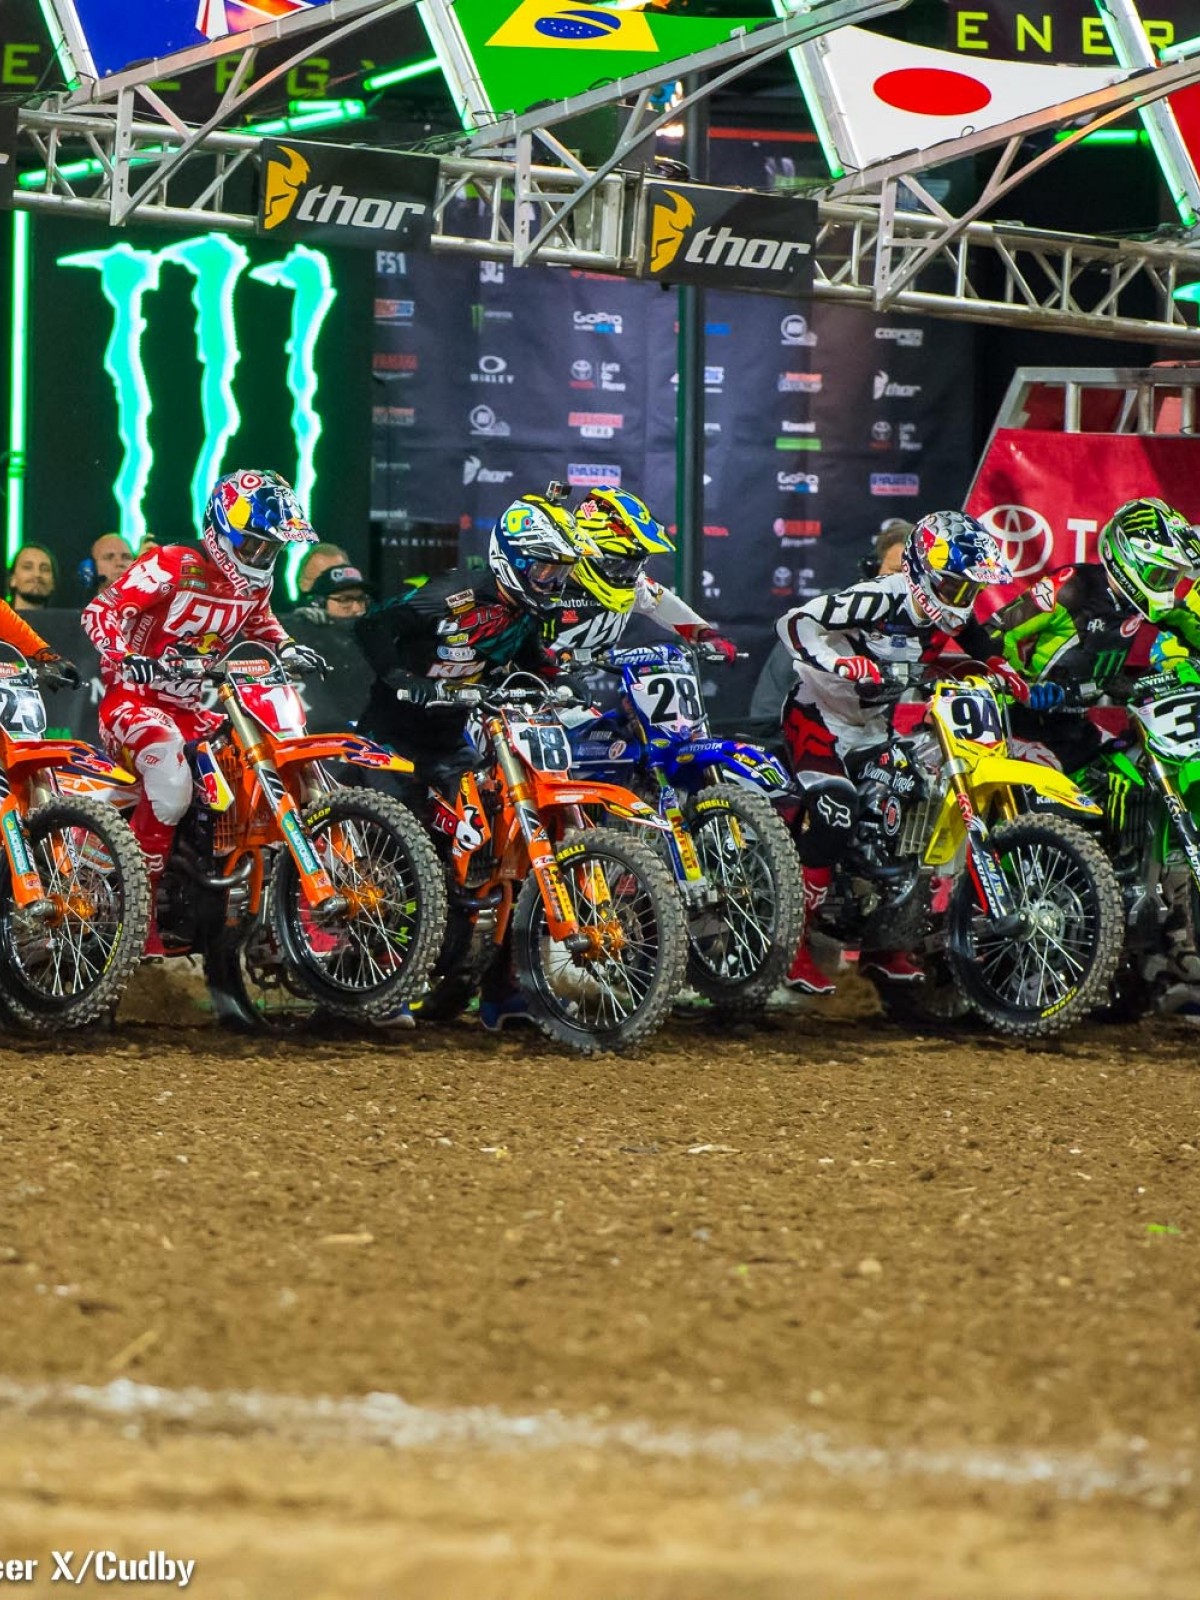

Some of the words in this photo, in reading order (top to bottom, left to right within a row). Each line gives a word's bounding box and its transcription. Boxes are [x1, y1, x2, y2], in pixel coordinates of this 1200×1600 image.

[296, 183, 425, 232] thor
[684, 226, 811, 271] thor
[261, 686, 301, 732] 1
[648, 677, 700, 724] 28
[951, 696, 1003, 740] 94
[519, 727, 569, 771] 18
[696, 799, 730, 813] PIRELLI
[972, 851, 1000, 919] DUNLOP
